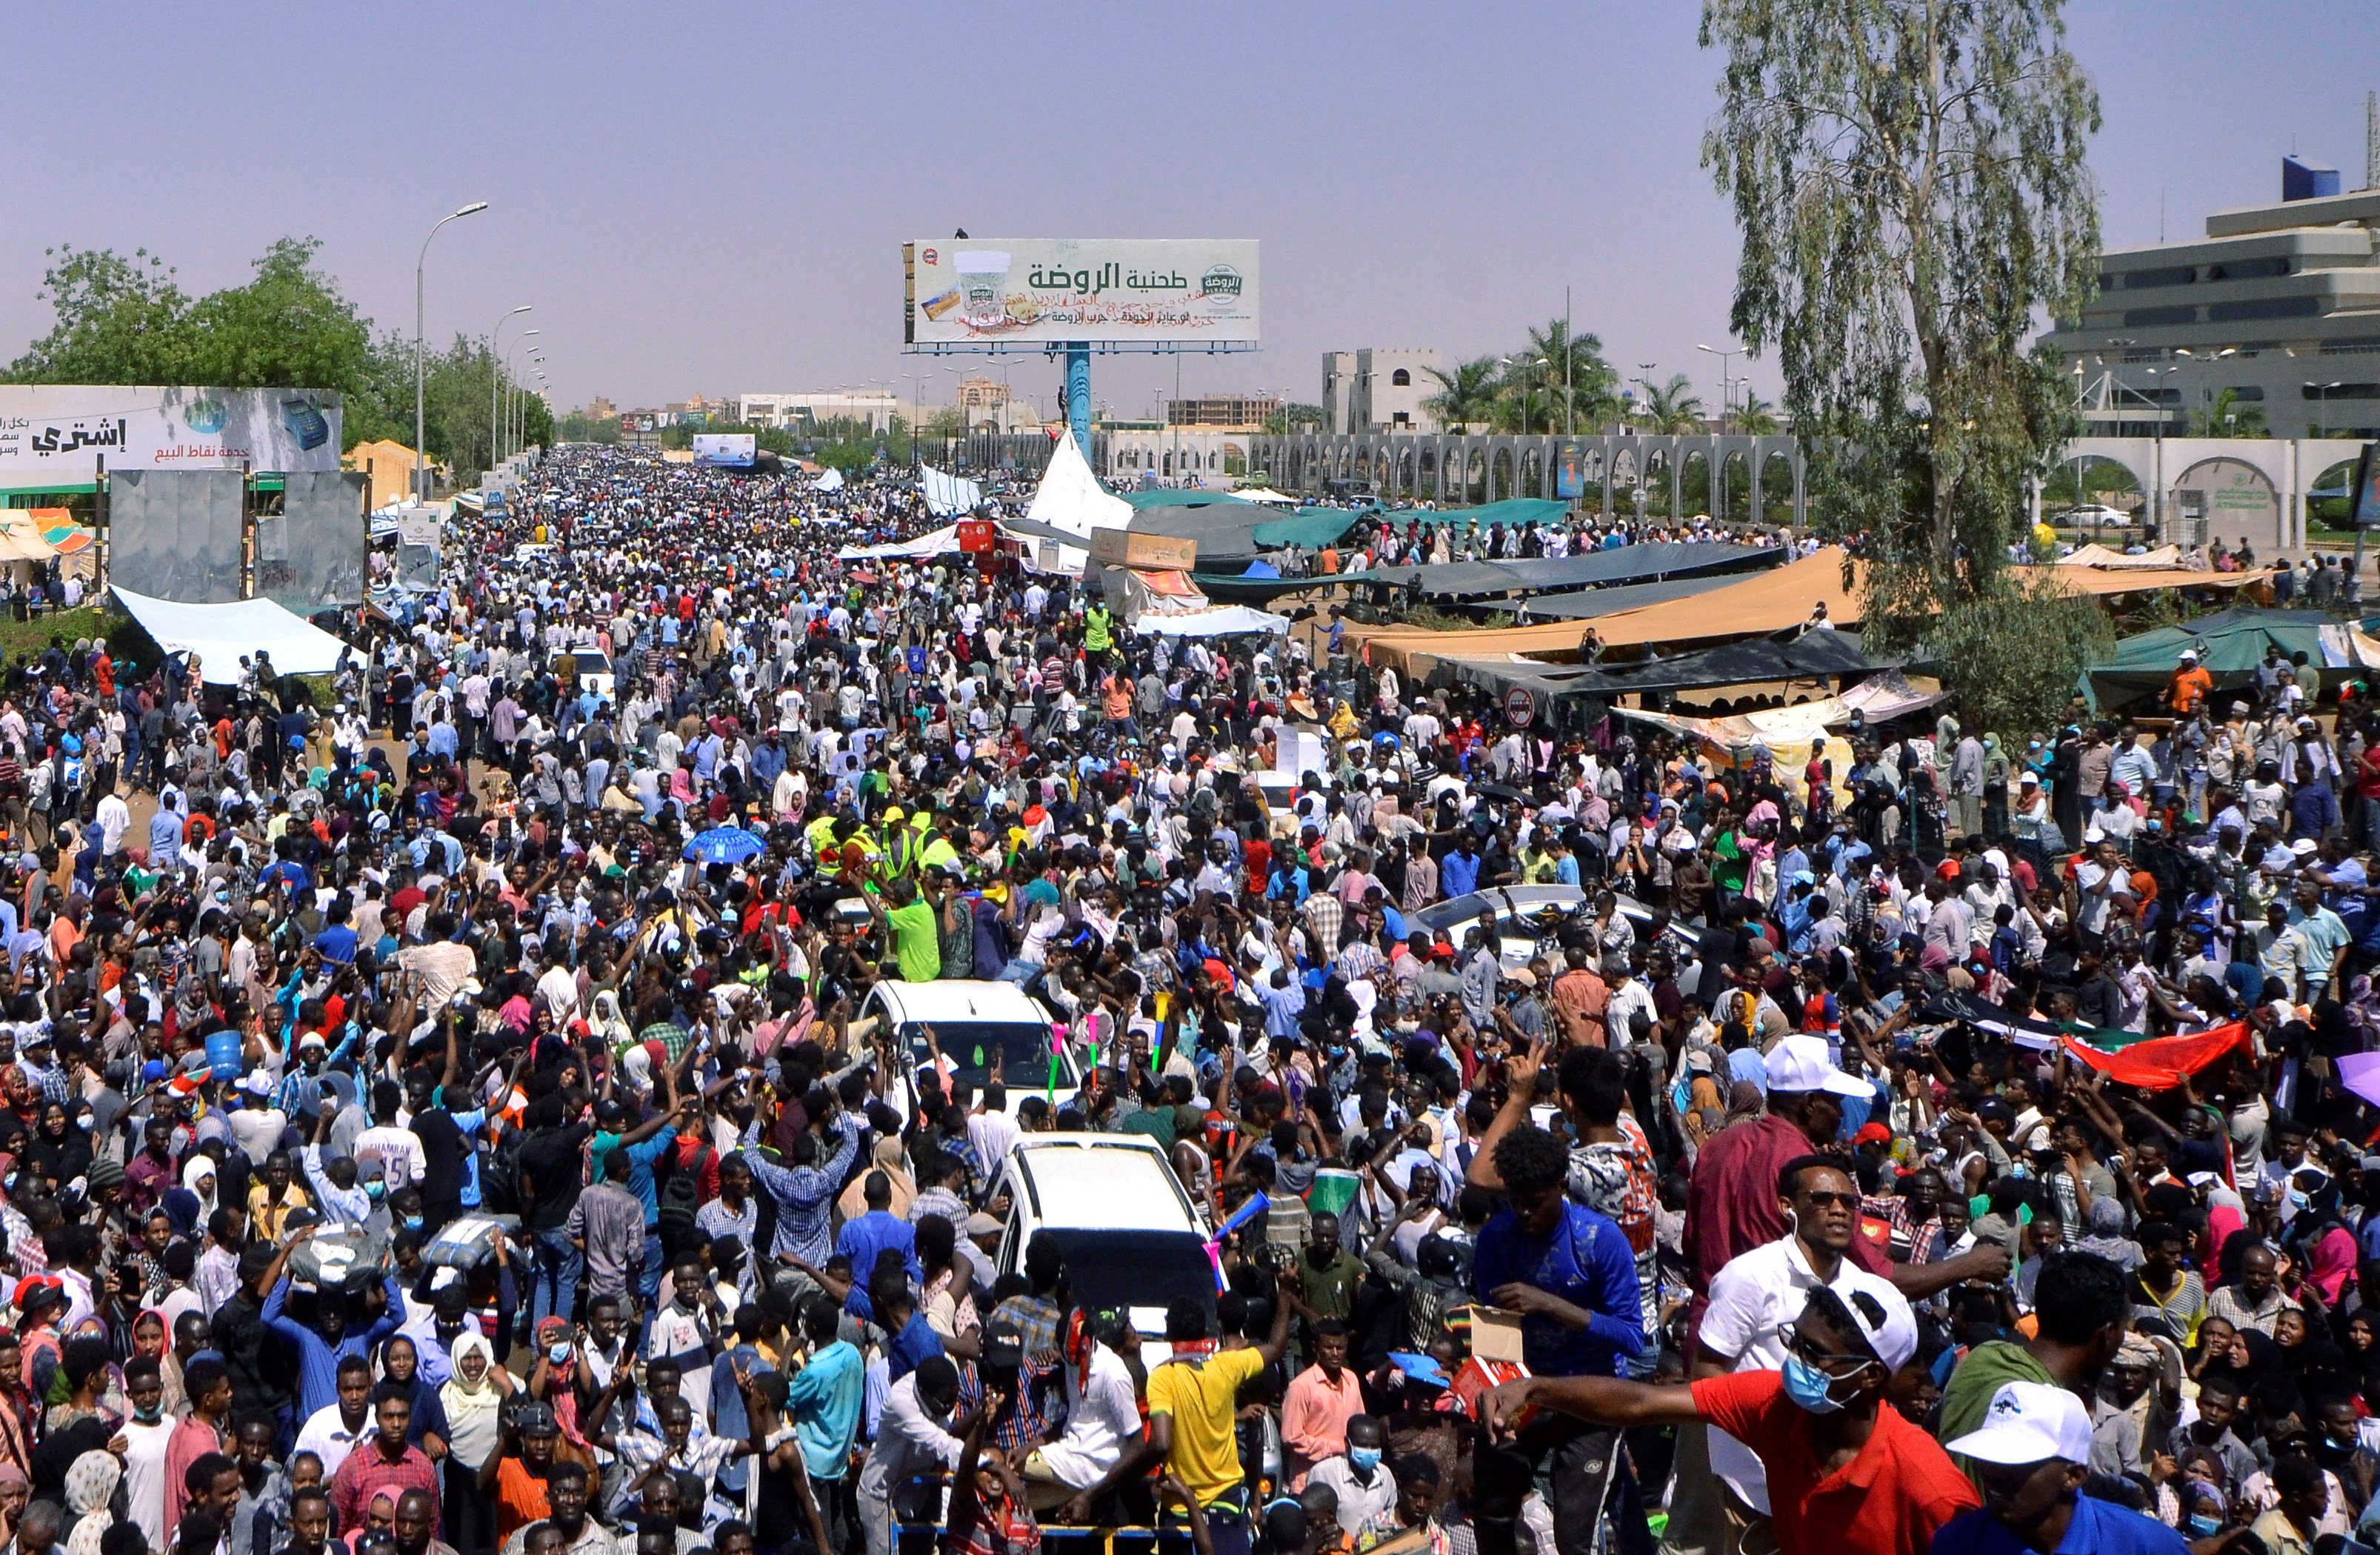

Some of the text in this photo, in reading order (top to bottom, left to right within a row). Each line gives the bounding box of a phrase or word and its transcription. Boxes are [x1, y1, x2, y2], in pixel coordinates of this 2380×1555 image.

[1028, 262, 1187, 295] طحنية الروضة
[1204, 276, 1240, 288] الروضة
[1052, 311, 1084, 324] الروضة
[8, 417, 30, 430] بكل
[32, 417, 126, 457] إشتري
[0, 446, 18, 456] وسر
[154, 444, 250, 463] خدمة نقاط البيع
